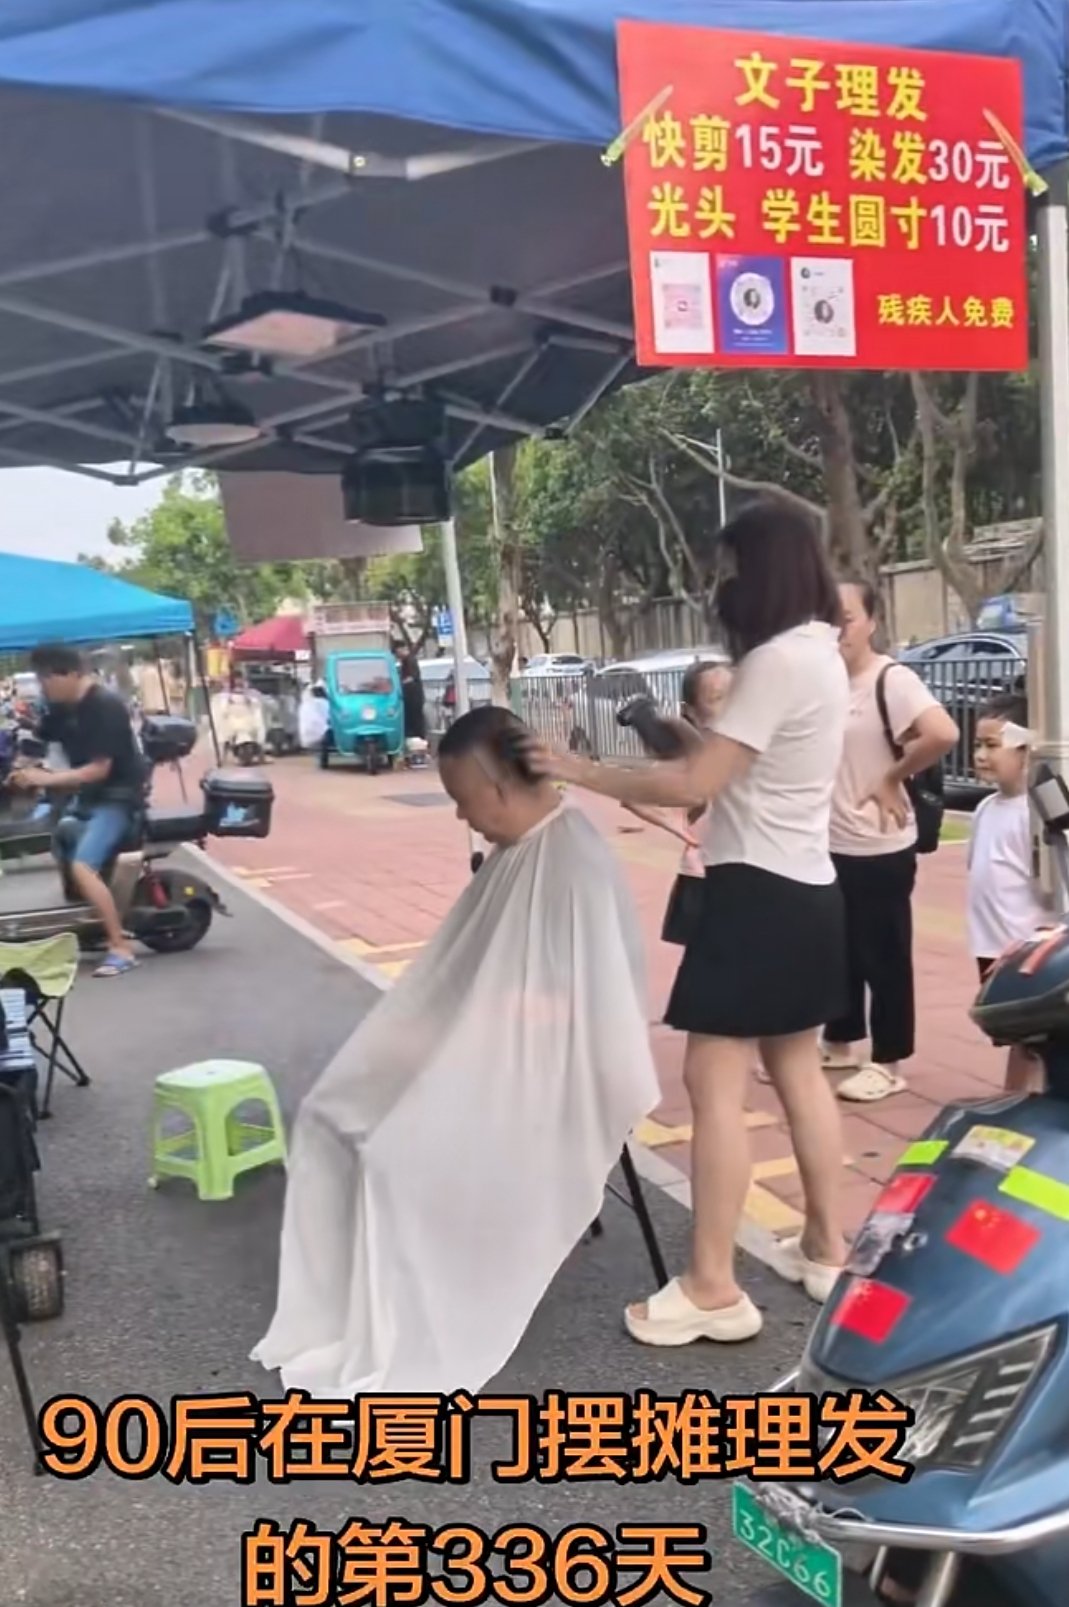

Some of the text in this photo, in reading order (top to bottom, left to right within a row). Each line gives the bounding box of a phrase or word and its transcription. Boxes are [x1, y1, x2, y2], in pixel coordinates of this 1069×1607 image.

[734, 51, 927, 122] 文子理发
[643, 110, 1010, 190] 快剪15元 染发30元
[647, 181, 1010, 253] 光头 学生圆寸10元
[876, 293, 1015, 329] 残疾人免费
